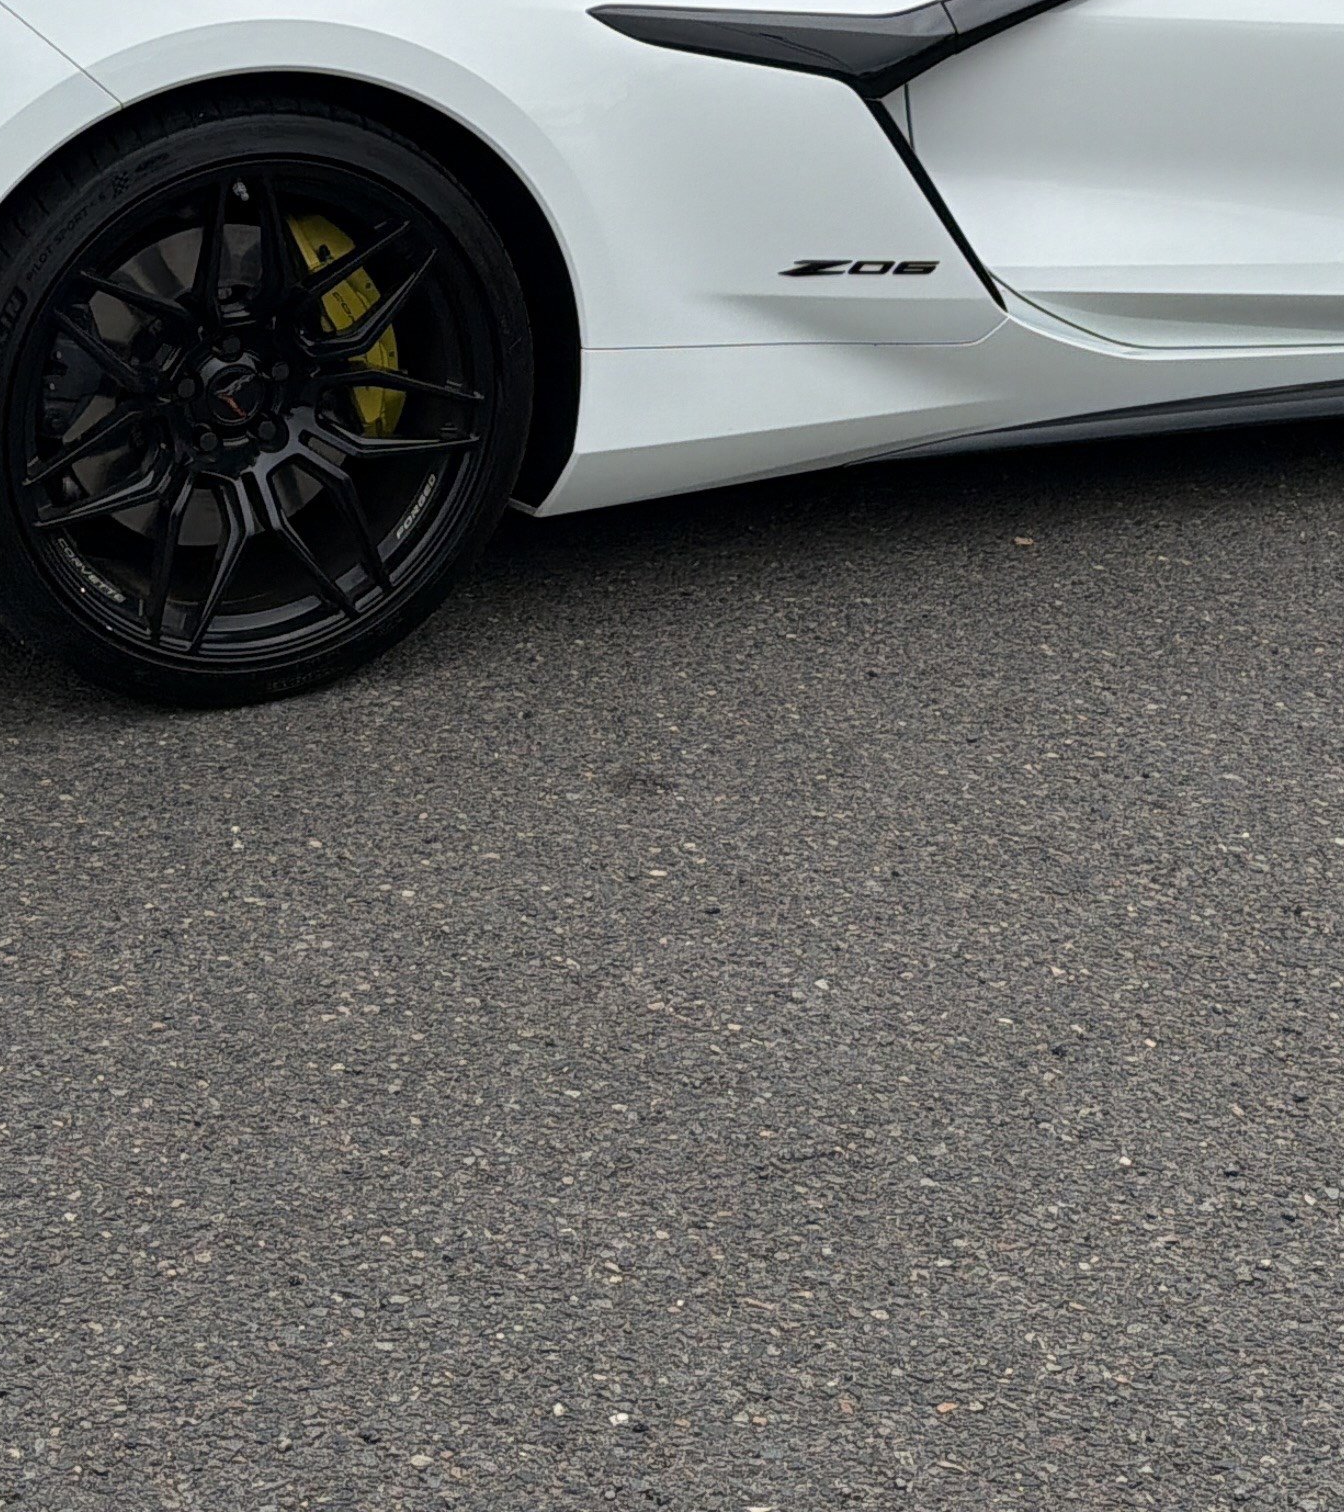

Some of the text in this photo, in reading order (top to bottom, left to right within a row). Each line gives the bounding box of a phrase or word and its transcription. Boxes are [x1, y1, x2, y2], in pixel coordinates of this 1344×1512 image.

[777, 259, 940, 277] Z06
[396, 472, 437, 540] FORGED
[57, 537, 128, 604] CORVETTE
